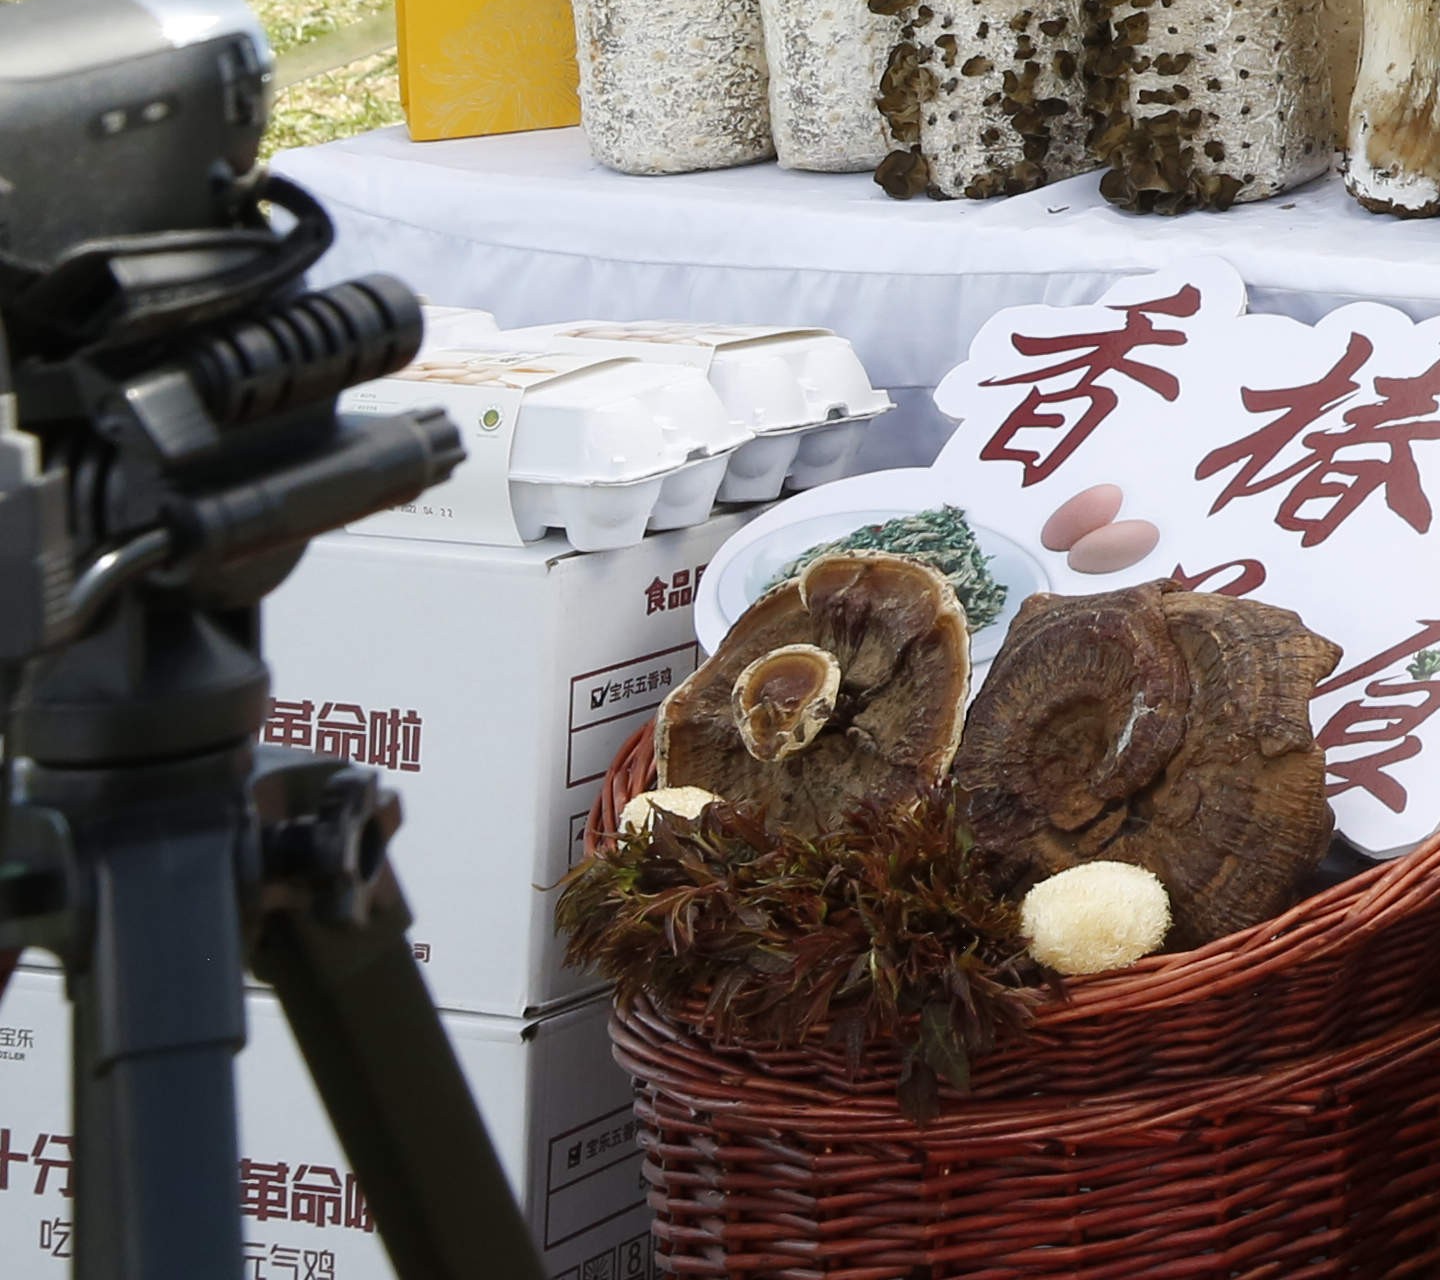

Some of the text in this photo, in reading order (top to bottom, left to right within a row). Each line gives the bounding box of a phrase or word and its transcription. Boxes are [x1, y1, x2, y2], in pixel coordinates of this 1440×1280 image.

[608, 666, 673, 704] 宝乐五香鸡
